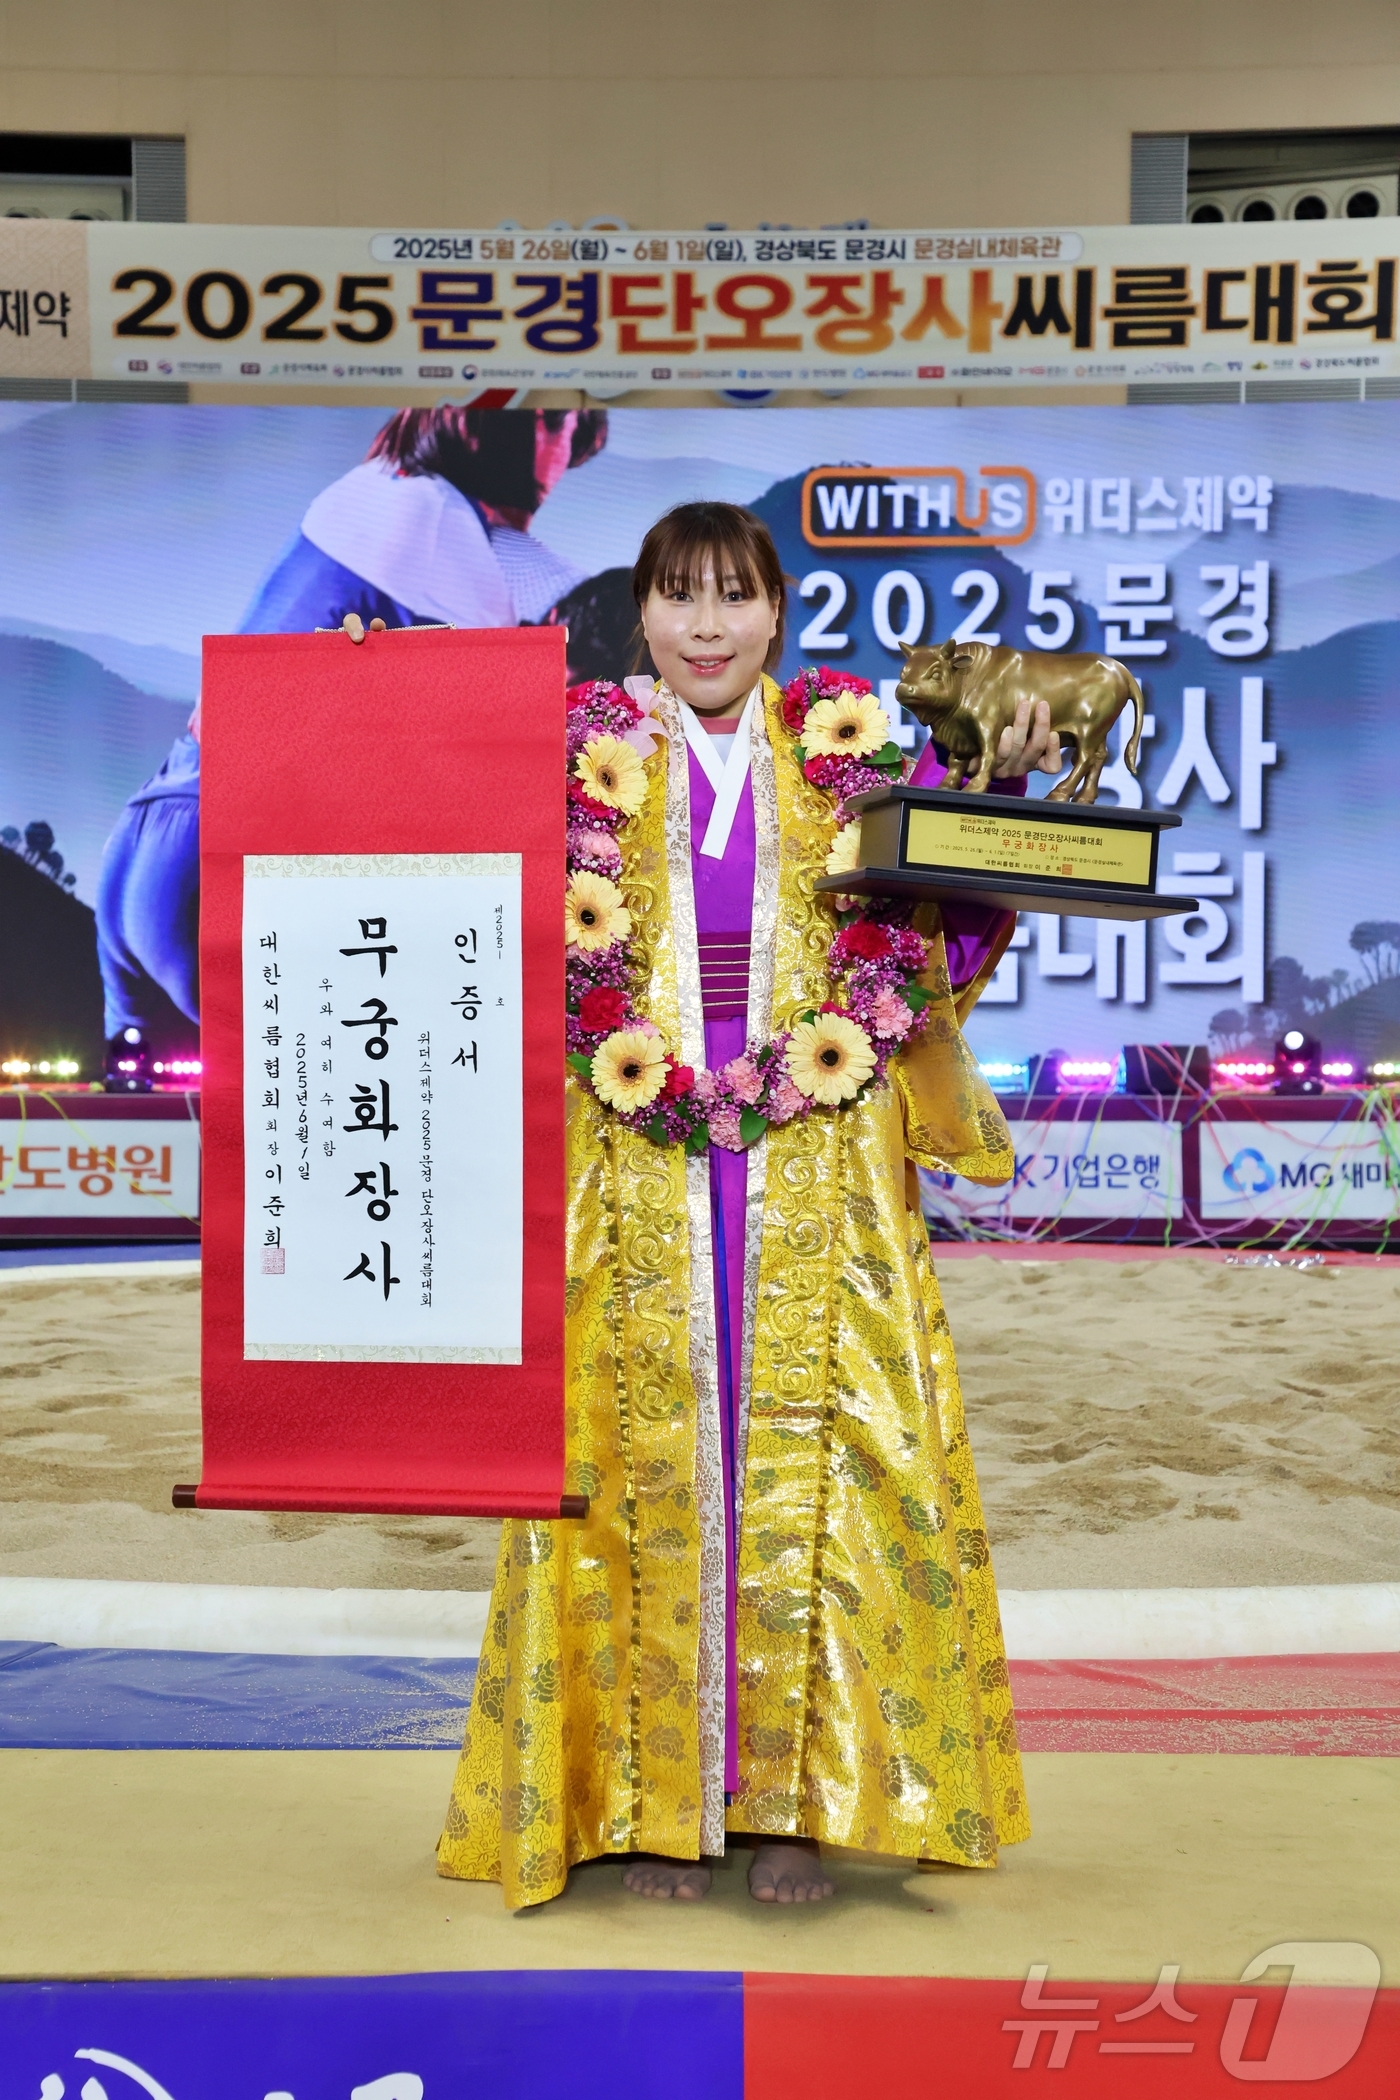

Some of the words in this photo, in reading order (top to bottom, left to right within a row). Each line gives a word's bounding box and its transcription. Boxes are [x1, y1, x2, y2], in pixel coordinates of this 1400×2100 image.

[394, 237, 473, 260] 2025년
[480, 238, 514, 261] 5월
[522, 238, 608, 262] 26일(월)
[633, 239, 668, 261] 6월
[754, 239, 837, 262] 경상북도
[845, 238, 906, 260] 문경시
[914, 235, 1062, 260] 문경실내체육관
[0, 289, 71, 337] 제약
[1044, 474, 1274, 534] 위더스제약
[959, 824, 1000, 837] 위더스제약
[1001, 828, 1022, 839] 2025
[1024, 830, 1104, 847] 문경단오장사씨름대회
[984, 859, 1020, 868] 대한씨름협회
[259, 931, 283, 1110] 대한씨름협회
[450, 927, 483, 1075] 인증서
[417, 1031, 434, 1105] 위더스제약
[338, 916, 401, 1302] 무궁화장사
[262, 1163, 286, 1249] 이준희
